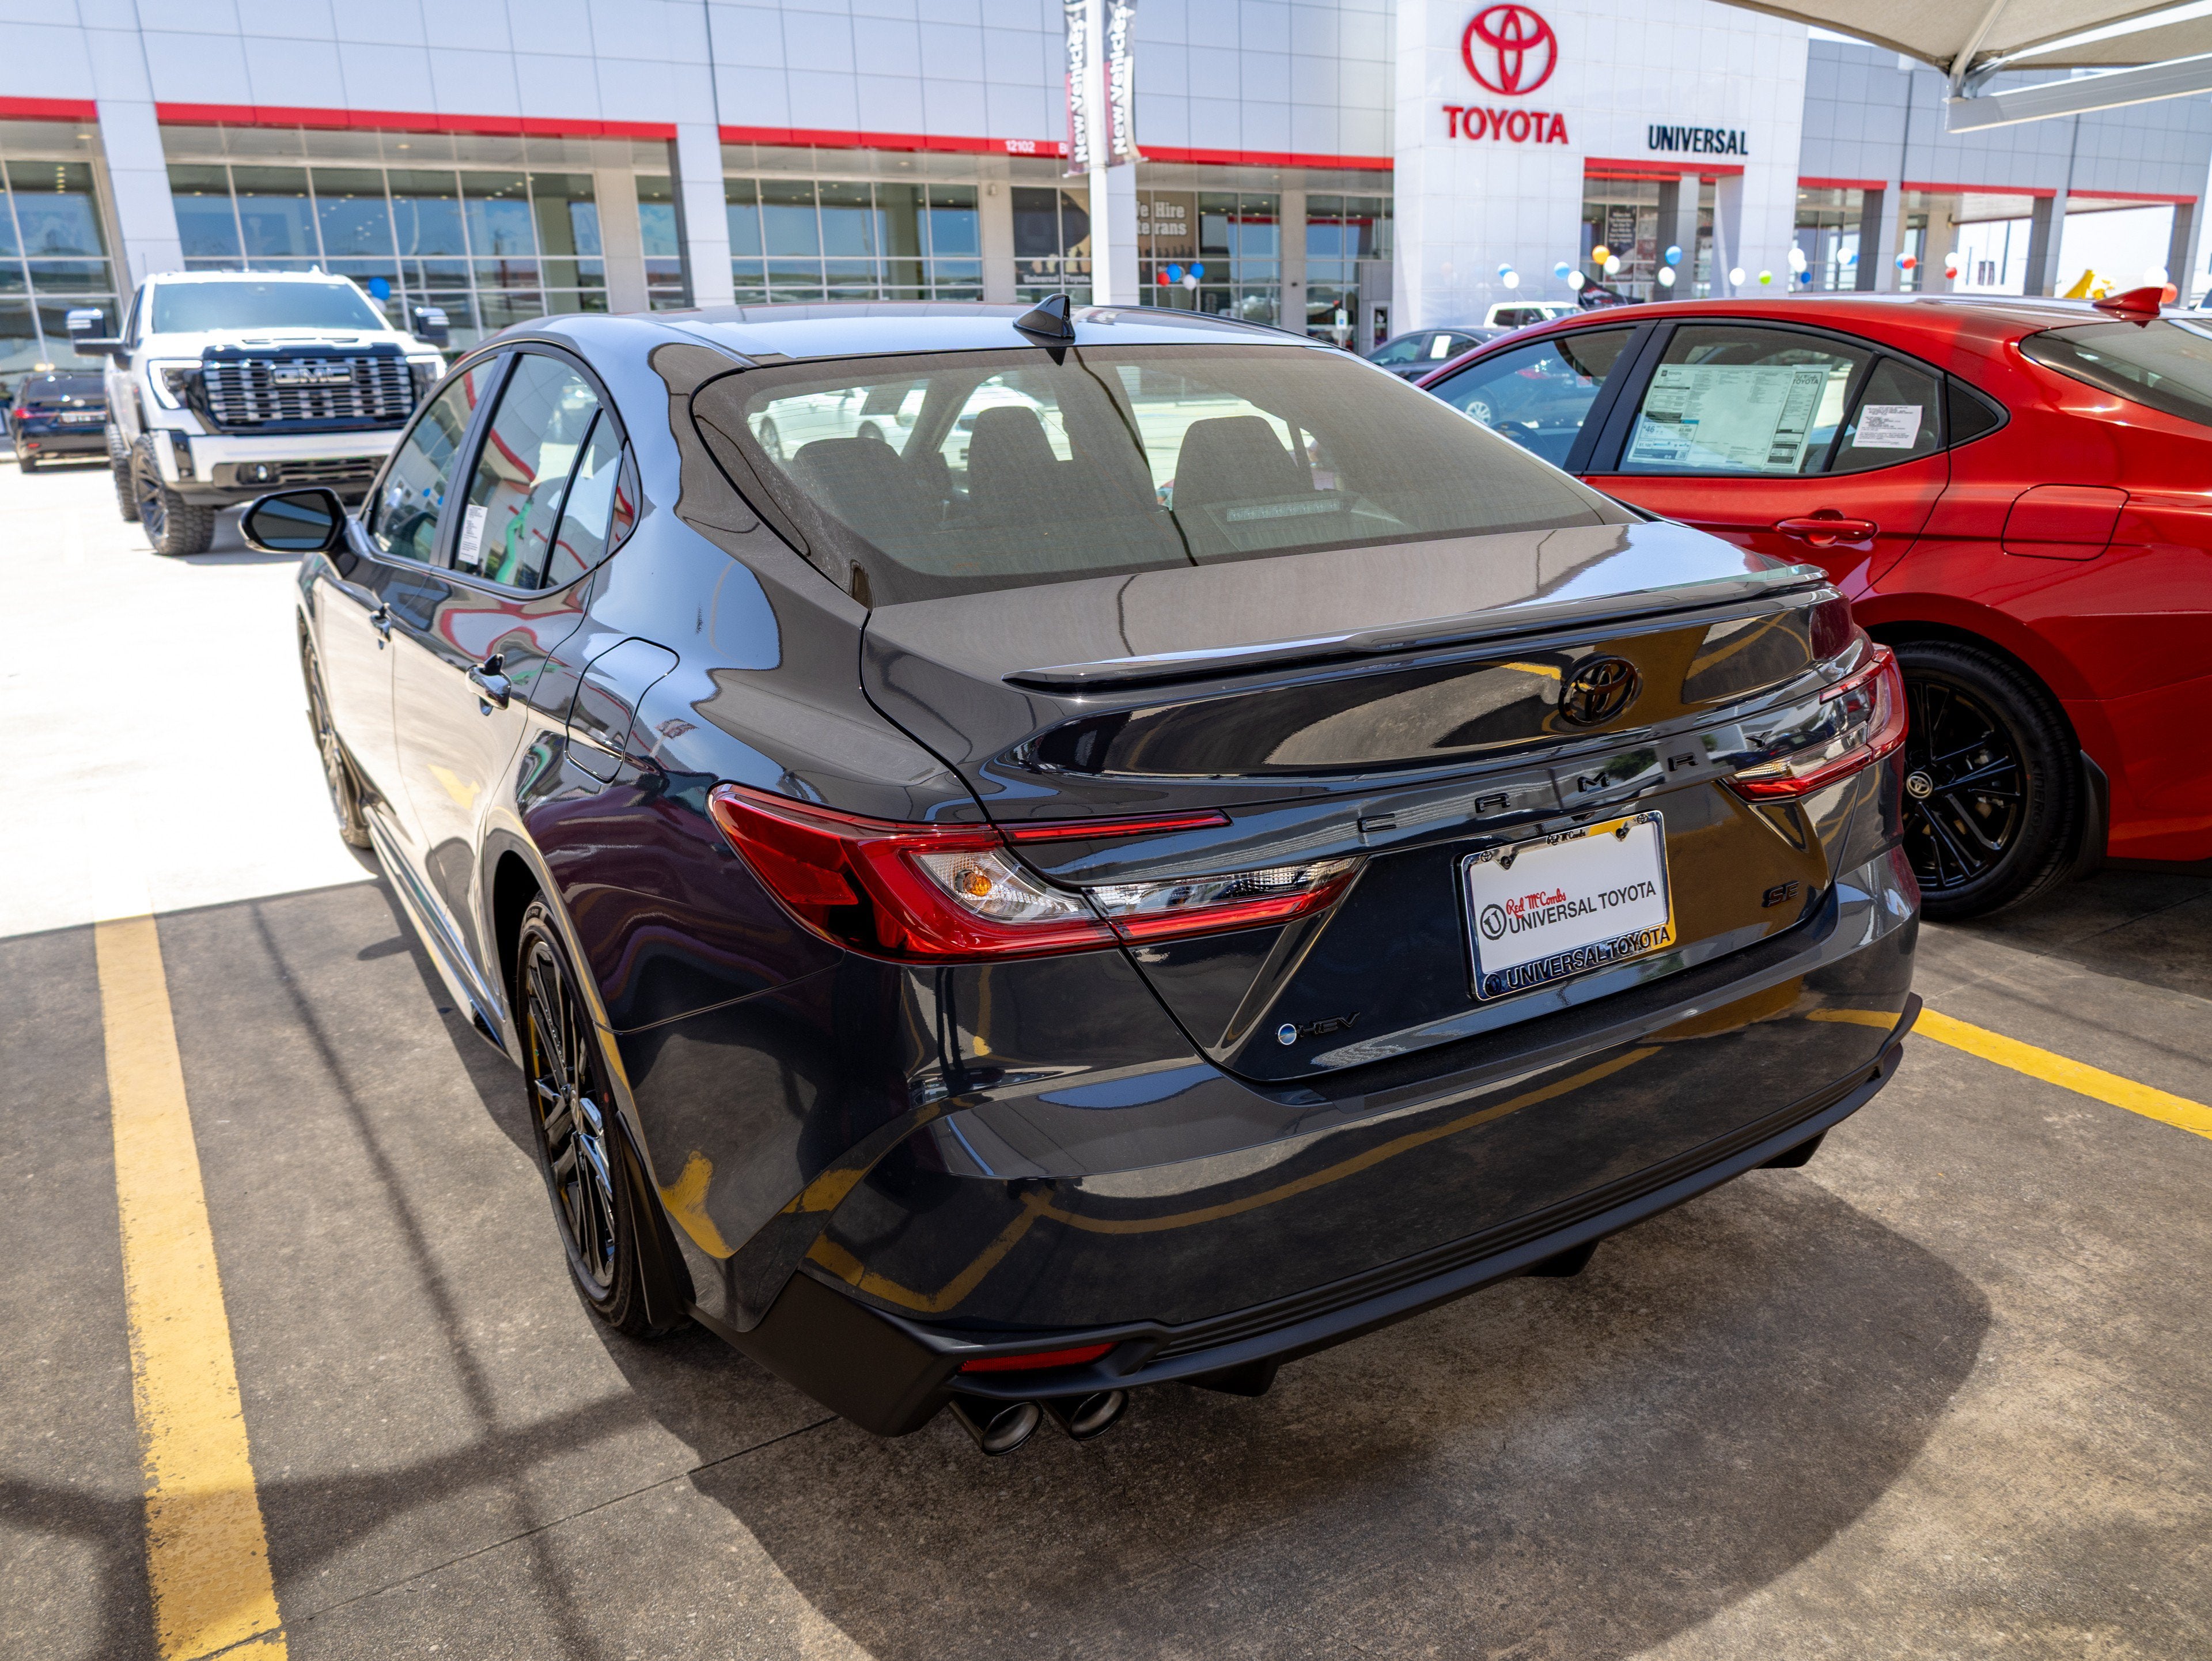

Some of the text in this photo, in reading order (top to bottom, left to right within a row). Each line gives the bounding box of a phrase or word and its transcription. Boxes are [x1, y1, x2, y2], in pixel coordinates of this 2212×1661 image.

[1070, 19, 1089, 163] New Vehicles
[1109, 5, 1129, 155] New Vehicles
[1442, 105, 1569, 145] TOYOTA
[1648, 124, 1748, 155] UNIVERSAL
[1005, 139, 1036, 153] 12102
[1154, 202, 1185, 218] Hire
[274, 368, 351, 384] GMC
[1357, 730, 1773, 834] CAMRY
[1506, 888, 1566, 919] Red McCombs
[1509, 880, 1657, 934] UNIVERSAL TOYOTA
[1761, 880, 1800, 907] SE
[1506, 944, 1607, 989] UNIVERSAL
[1607, 925, 1671, 959] TOYOTA
